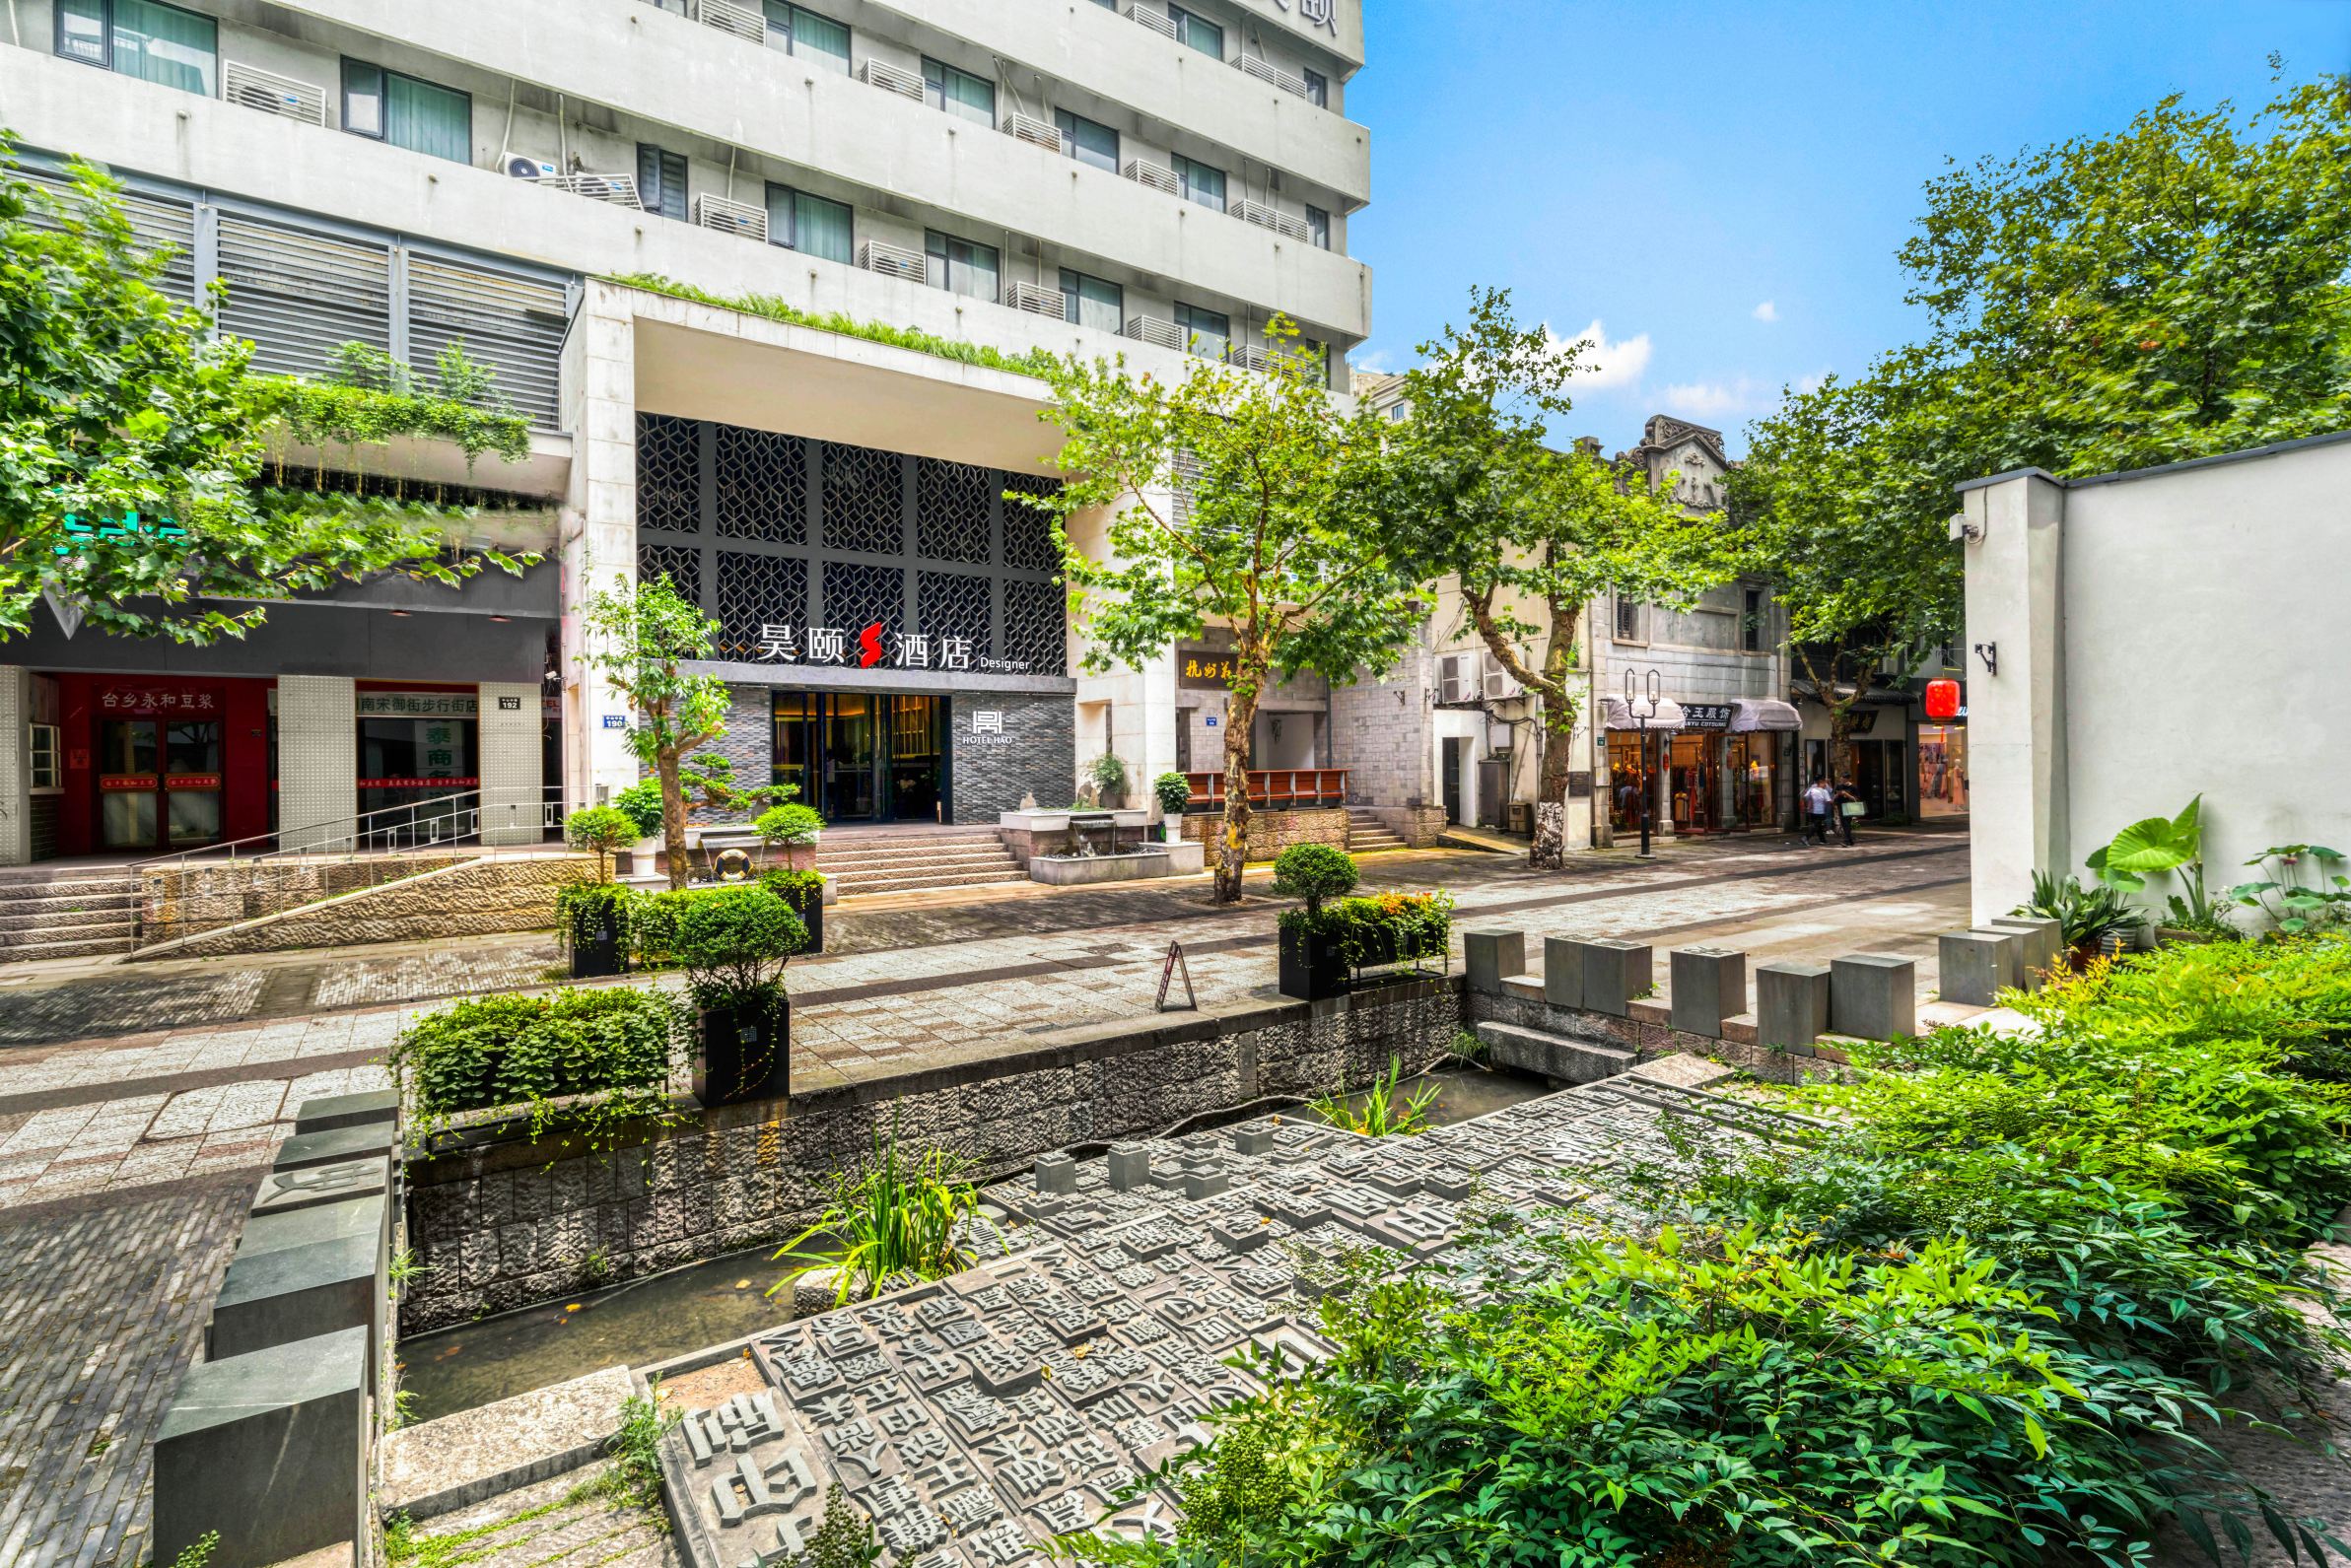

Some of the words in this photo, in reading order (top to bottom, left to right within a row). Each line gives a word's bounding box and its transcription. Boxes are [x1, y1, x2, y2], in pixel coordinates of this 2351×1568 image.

[758, 623, 845, 663] 昊颐
[895, 632, 973, 669] 酒店
[980, 656, 1030, 671] Designer
[102, 692, 214, 710] 台乡永和豆浆
[356, 698, 478, 713] 南宋御街步行街店
